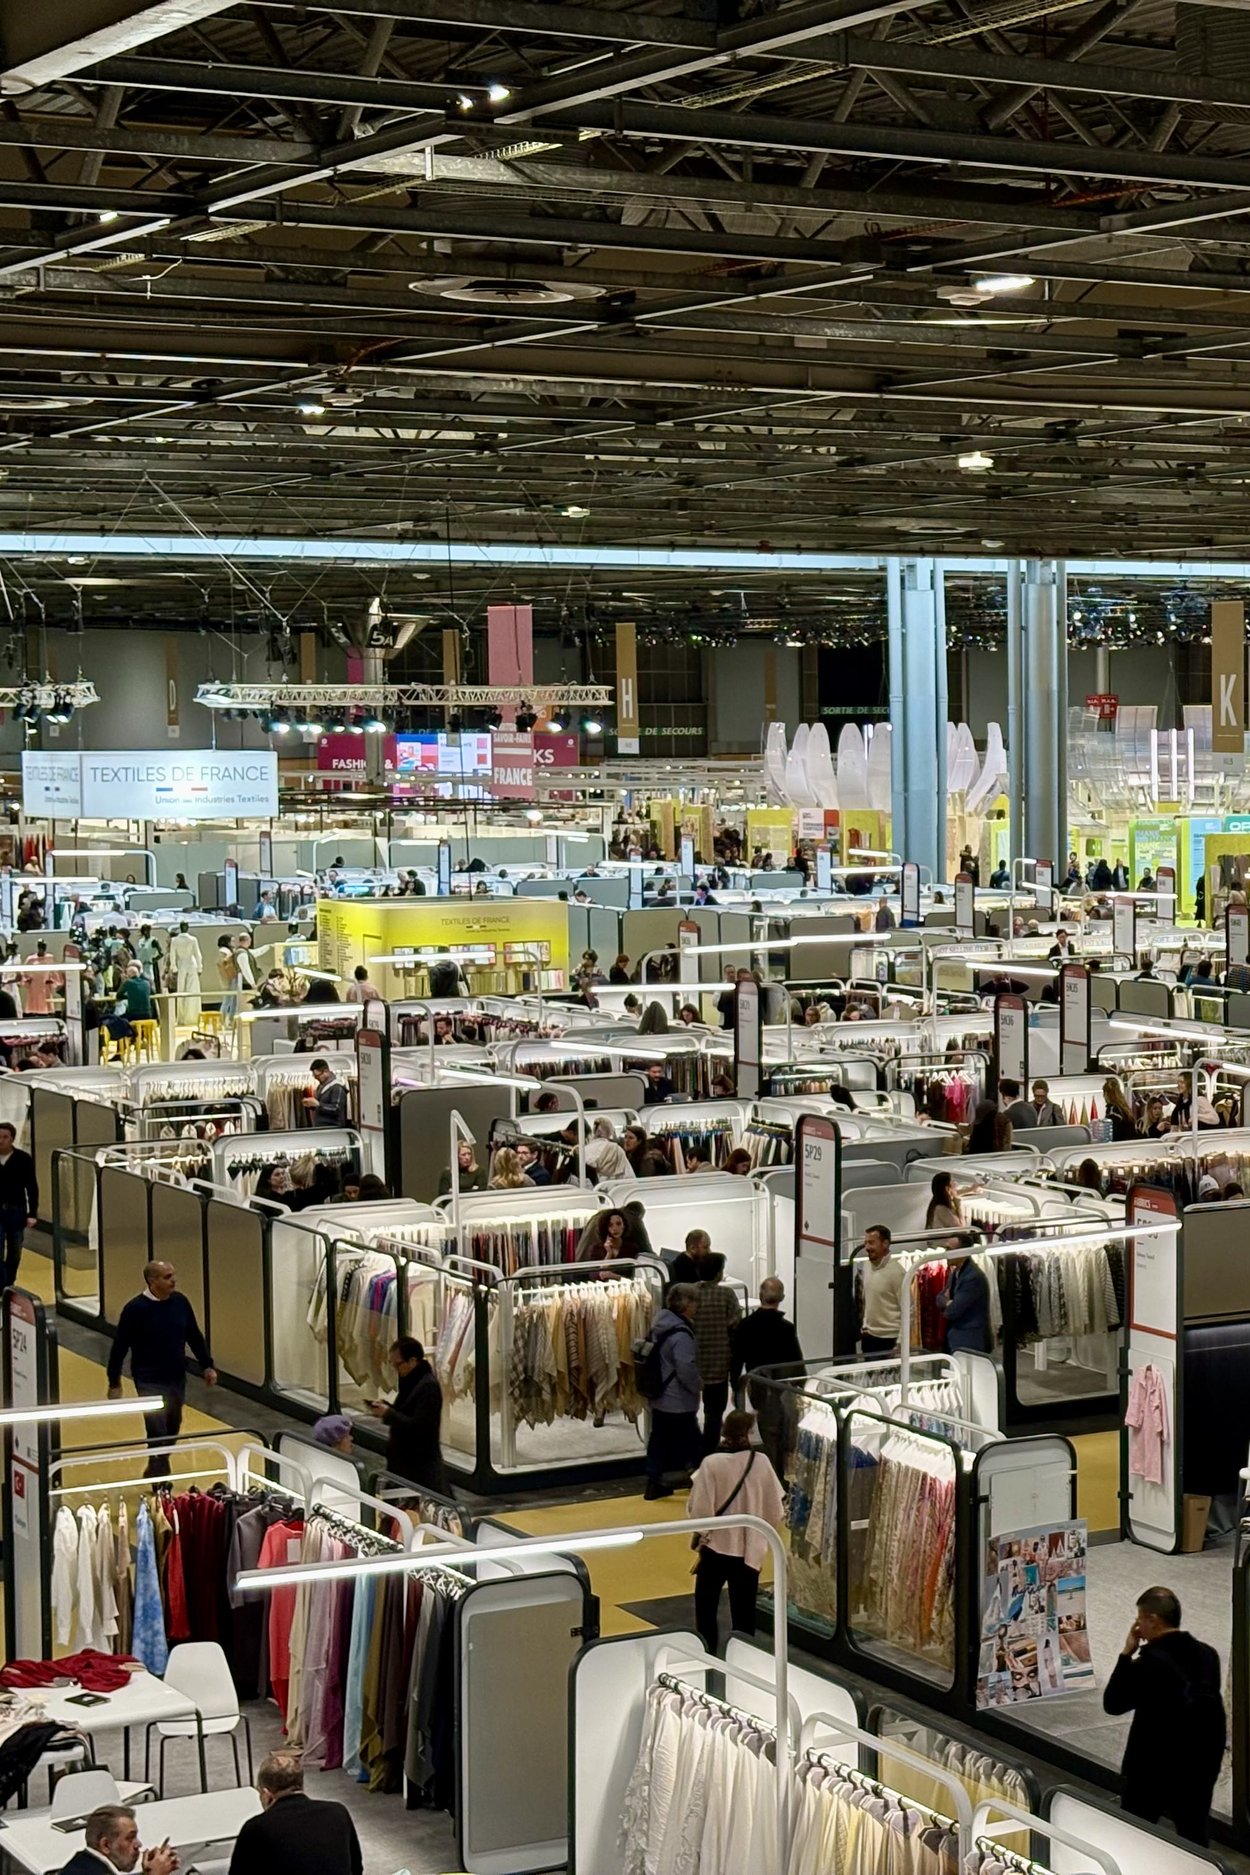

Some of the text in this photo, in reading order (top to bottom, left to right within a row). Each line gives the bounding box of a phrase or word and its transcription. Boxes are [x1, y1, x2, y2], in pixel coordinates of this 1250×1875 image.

[370, 631, 393, 646] 5A
[621, 678, 633, 718] H
[1220, 674, 1238, 726] K
[823, 706, 853, 715] SORTIE
[857, 706, 870, 715] DE
[645, 727, 658, 736] DE
[661, 727, 704, 736] SECOURS
[90, 764, 269, 783] TEXTILES DE FRANCE
[494, 767, 533, 786] FRANCE
[155, 795, 180, 804] Union
[194, 794, 235, 804] Industries
[237, 794, 269, 804] Textiles
[805, 1144, 822, 1162] 5P29
